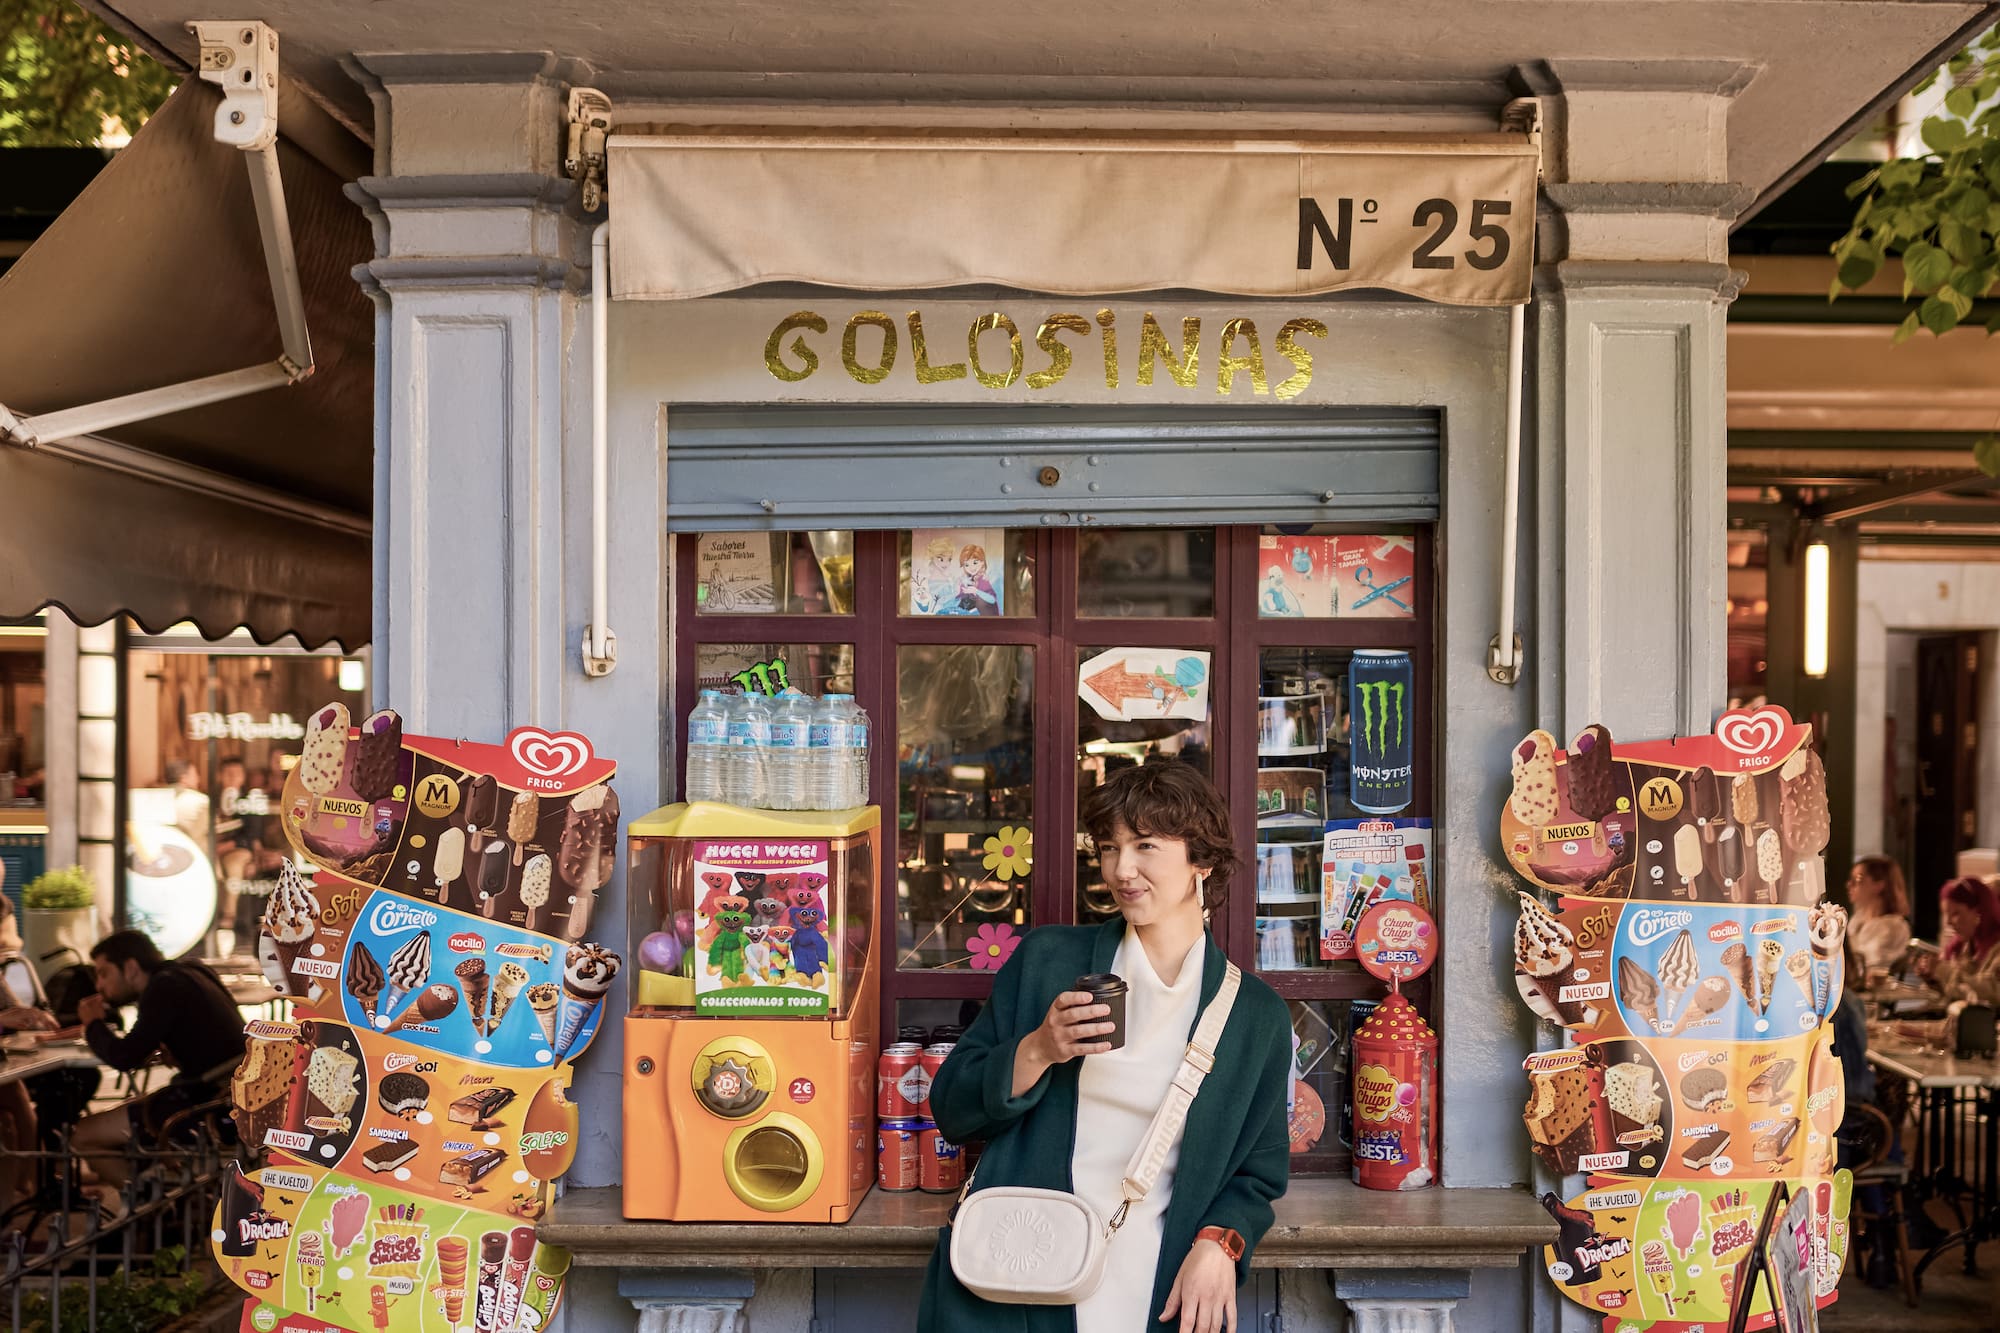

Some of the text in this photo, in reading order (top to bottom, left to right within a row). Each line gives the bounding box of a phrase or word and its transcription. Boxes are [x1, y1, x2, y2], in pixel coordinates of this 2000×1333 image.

[1412, 197, 1512, 271] 25
[763, 307, 1330, 401] GOLOSINAS
[1739, 756, 1771, 768] FRIGO
[1352, 764, 1412, 782] MONSTER
[527, 777, 563, 790] FRIGO
[1359, 781, 1407, 789] ENERGY
[425, 781, 449, 804] M
[1649, 786, 1673, 806] M
[323, 799, 362, 815] NUEVOS
[421, 801, 452, 811] MAGNUM
[1647, 804, 1678, 814] MAGNUM
[1359, 823, 1394, 832] FIESTA
[1547, 825, 1590, 840] NUEVOS
[764, 844, 818, 859] WUGGI
[1364, 848, 1397, 865] AQUÍ
[321, 887, 362, 925] Soft
[370, 900, 438, 936] Cornetto
[1384, 918, 1414, 929] Chupa
[1382, 928, 1412, 940] Chups
[1576, 905, 1616, 950] Soft
[1628, 909, 1693, 946] Cornetto
[1710, 925, 1739, 939] nocilla
[450, 938, 483, 950] nocilla
[496, 943, 542, 956] Filipinos
[1325, 940, 1353, 948] FIESTA
[1386, 951, 1412, 961] BEST
[298, 960, 334, 976] NUEVO
[1565, 985, 1604, 999] NUEVO
[700, 997, 823, 1008] COLECCIONALOS TODOS
[244, 1019, 300, 1037] Filipinos
[384, 1052, 419, 1072] Cornetto
[1523, 1053, 1585, 1071] Filipinos
[1708, 1051, 1729, 1066] GO!
[414, 1061, 439, 1073] GO!
[793, 1081, 812, 1095] 2€
[1357, 1077, 1393, 1096] Chupa
[1356, 1090, 1392, 1113] Chups
[368, 1127, 409, 1141] SANDWICH
[1618, 1131, 1654, 1143] Filipinos
[1681, 1123, 1719, 1138] SANDWICH
[271, 1132, 307, 1148] NUEVO
[519, 1131, 569, 1157] SOLERO
[1360, 1143, 1393, 1160] BEST
[1584, 1155, 1623, 1169] NUEVO
[279, 1175, 309, 1190] VUELTO!
[1605, 1193, 1637, 1207] VUELTO!
[239, 1219, 290, 1243] DRACULA
[374, 1236, 417, 1253] FRIGO
[1575, 1238, 1631, 1268] DRACULA
[296, 1256, 326, 1267] HARIBO
[1644, 1264, 1674, 1274] HARIBO
[250, 1279, 267, 1288] FRUTA
[543, 1290, 557, 1317] LIME
[1604, 1299, 1622, 1308] FRUTA
